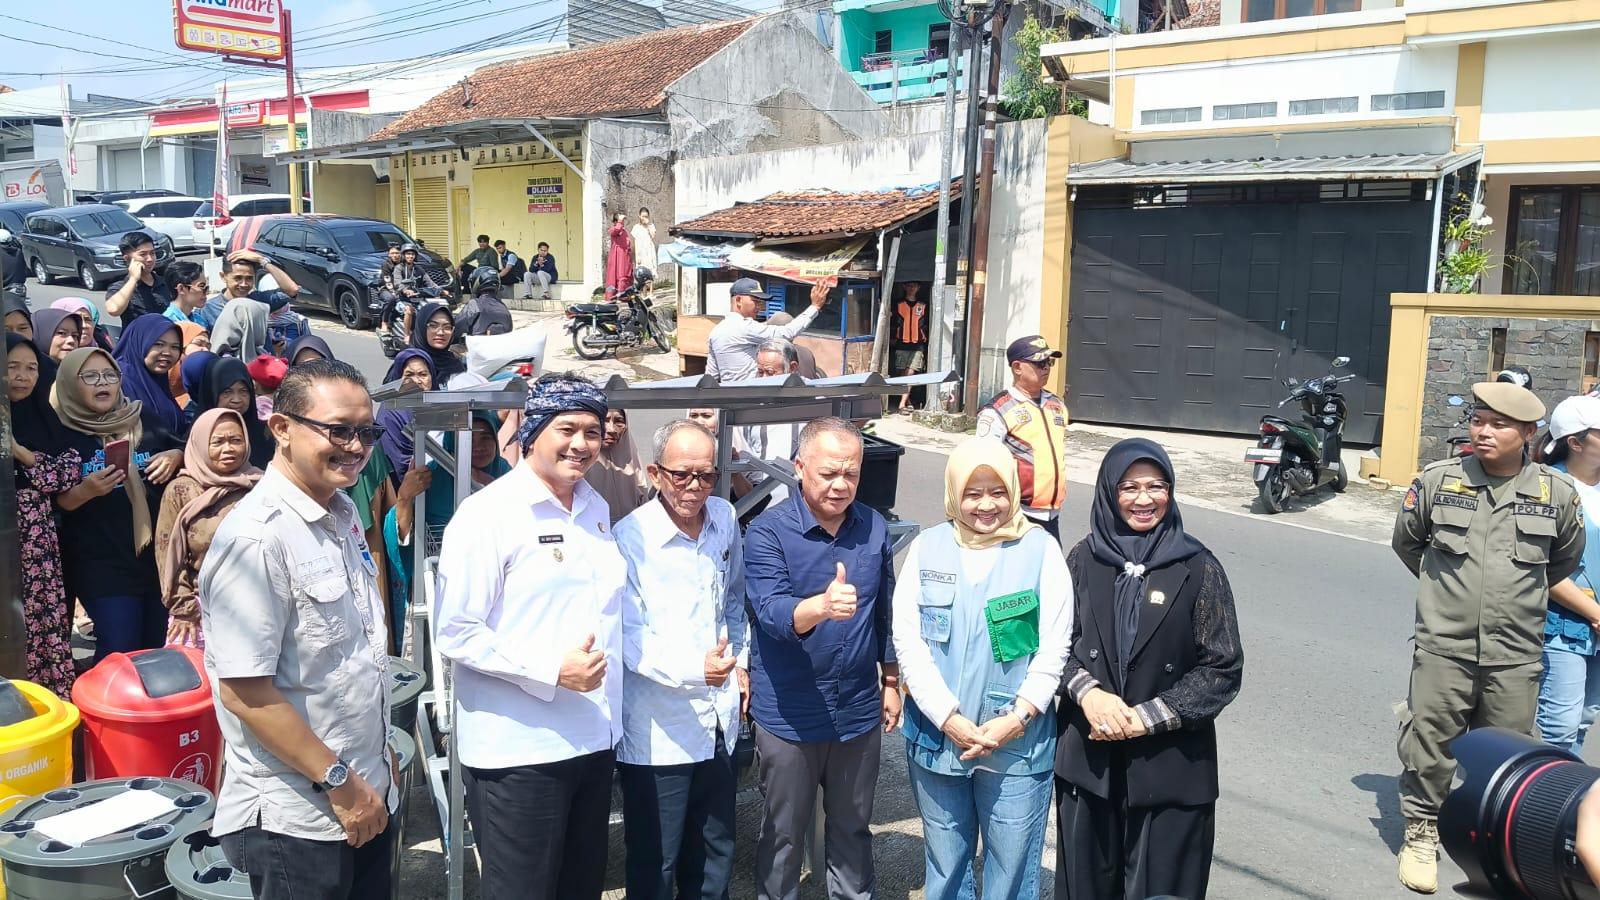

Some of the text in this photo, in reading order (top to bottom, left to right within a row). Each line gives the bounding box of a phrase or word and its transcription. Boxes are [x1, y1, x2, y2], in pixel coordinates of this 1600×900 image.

[188, 0, 274, 13] amart
[1518, 505, 1555, 516] POL PP
[922, 571, 952, 582] NONKA
[996, 595, 1032, 611] JABAR
[179, 729, 200, 747] B3
[6, 756, 49, 780] ORGANIK
